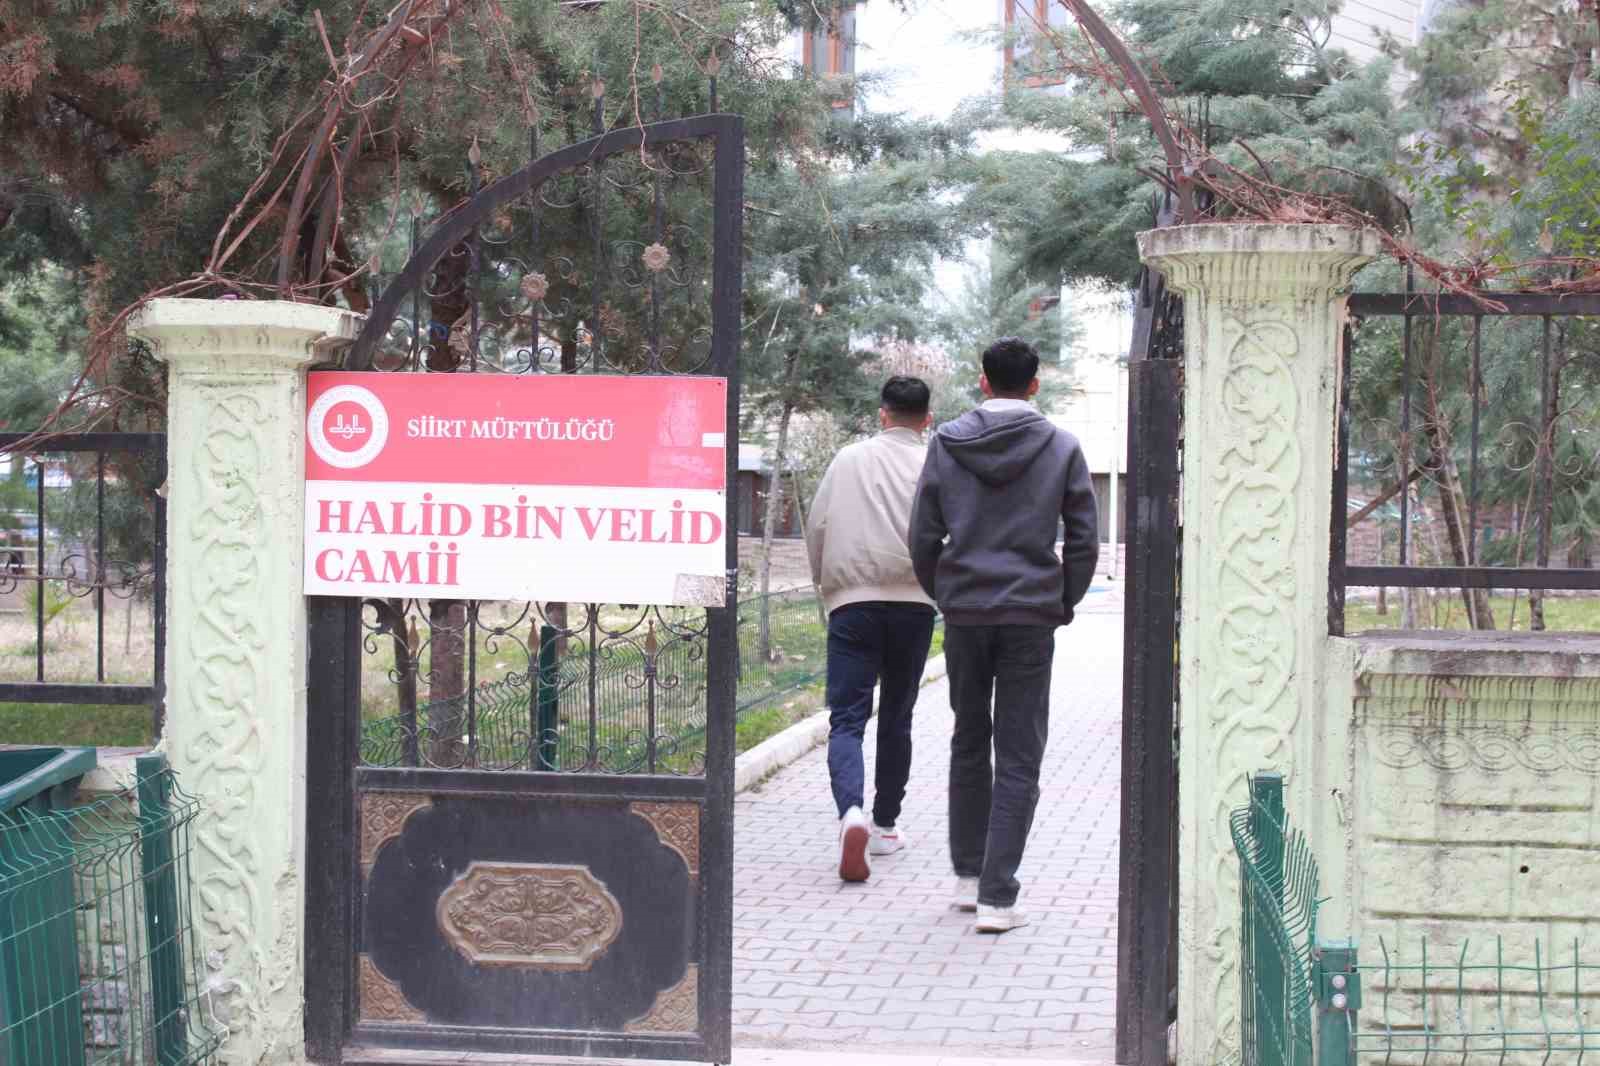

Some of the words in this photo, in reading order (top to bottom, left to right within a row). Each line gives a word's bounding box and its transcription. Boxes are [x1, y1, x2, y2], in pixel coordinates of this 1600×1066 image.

[407, 416, 466, 438] SİİRT
[471, 417, 614, 441] MÜFTÜLÜĞÜ
[316, 493, 472, 536] HALİD
[481, 495, 565, 540] BİN
[574, 499, 723, 545] VELİD
[314, 541, 460, 586] CAMİİ
